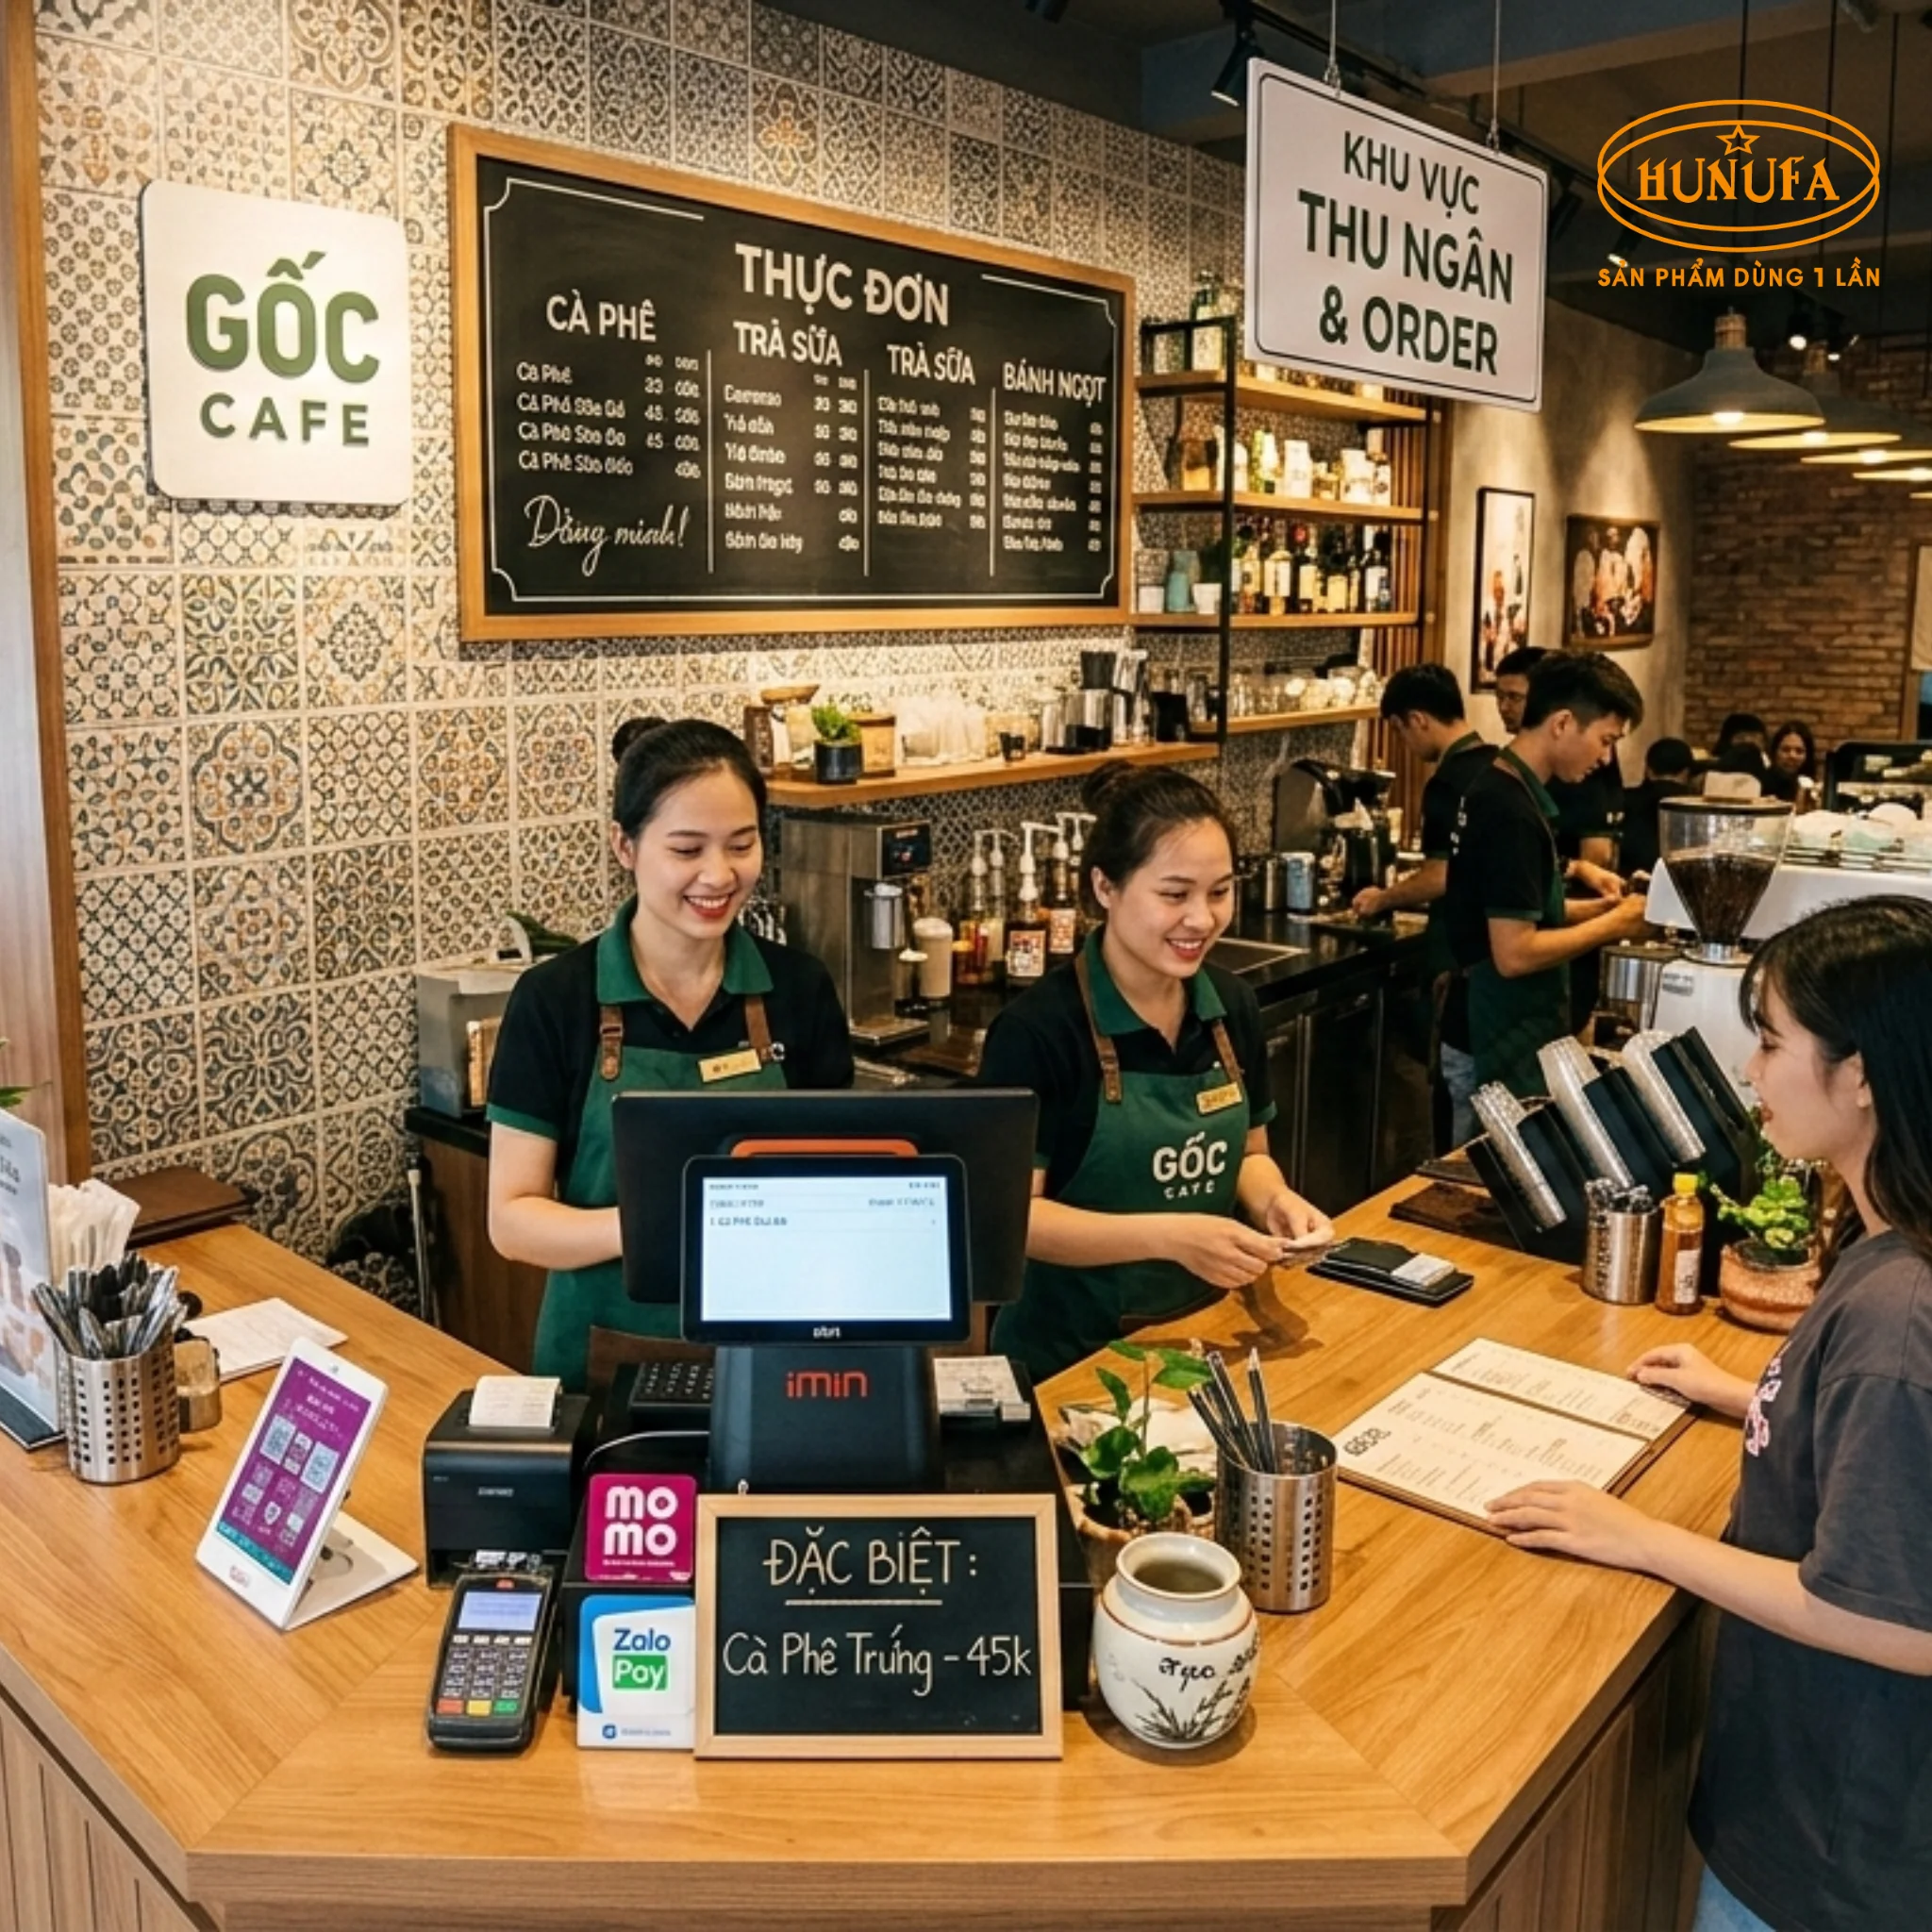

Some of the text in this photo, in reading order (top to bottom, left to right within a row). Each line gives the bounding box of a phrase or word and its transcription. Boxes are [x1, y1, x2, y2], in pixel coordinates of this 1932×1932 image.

[1342, 130, 1411, 192] KHU
[1298, 189, 1513, 305] THU NGÂN
[735, 242, 949, 327] THỰC ĐƠN
[186, 251, 379, 385] GỐC
[545, 288, 657, 342] CÀ PHÊ
[1320, 285, 1498, 375] & ORDER
[1003, 358, 1055, 396] BÁNH
[199, 392, 370, 446] CAFE
[1153, 1131, 1227, 1183] GỐC
[762, 1525, 853, 1595] ĐẶC
[613, 1627, 671, 1652] Zalo
[722, 1632, 769, 1675] Cà
[781, 1632, 839, 1675] Phê
